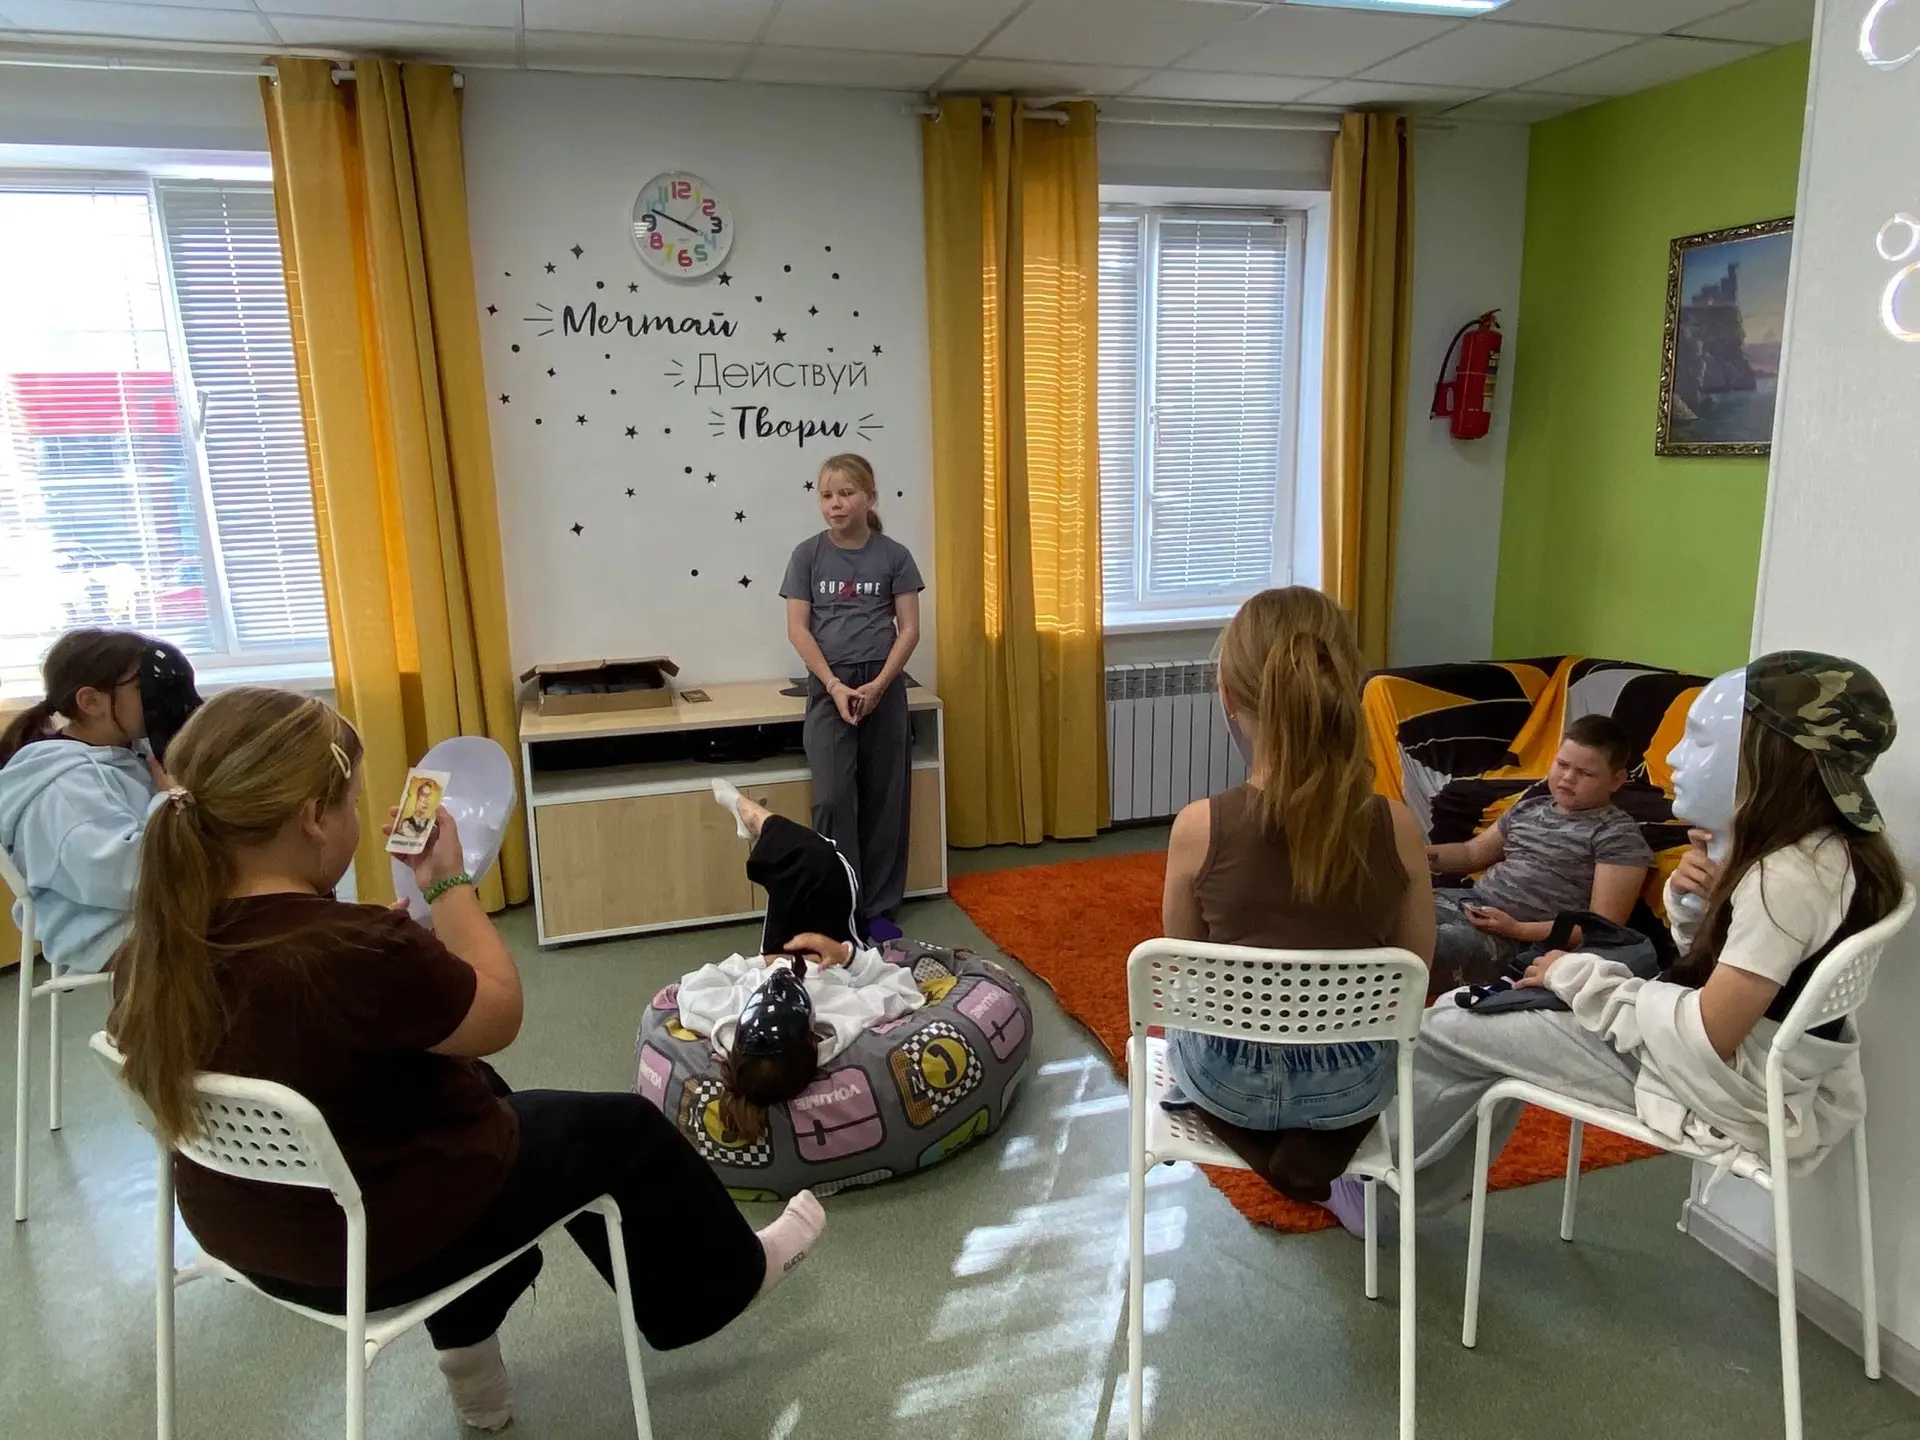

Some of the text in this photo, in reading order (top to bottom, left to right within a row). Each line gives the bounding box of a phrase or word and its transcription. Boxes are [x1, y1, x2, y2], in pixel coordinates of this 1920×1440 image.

[671, 181, 692, 200] 12
[702, 198, 716, 217] 2
[641, 213, 657, 232] 9
[710, 216, 723, 234] 3
[650, 232, 664, 251] 8
[704, 233, 717, 251] 4
[663, 243, 675, 261] 7
[677, 249, 693, 268] 6
[694, 243, 708, 262] 5
[563, 301, 739, 338] Мечтай
[694, 353, 868, 396] Действуй
[730, 405, 849, 449] Твори
[819, 580, 881, 596] SUPEME
[794, 1083, 862, 1111] VOLUME
